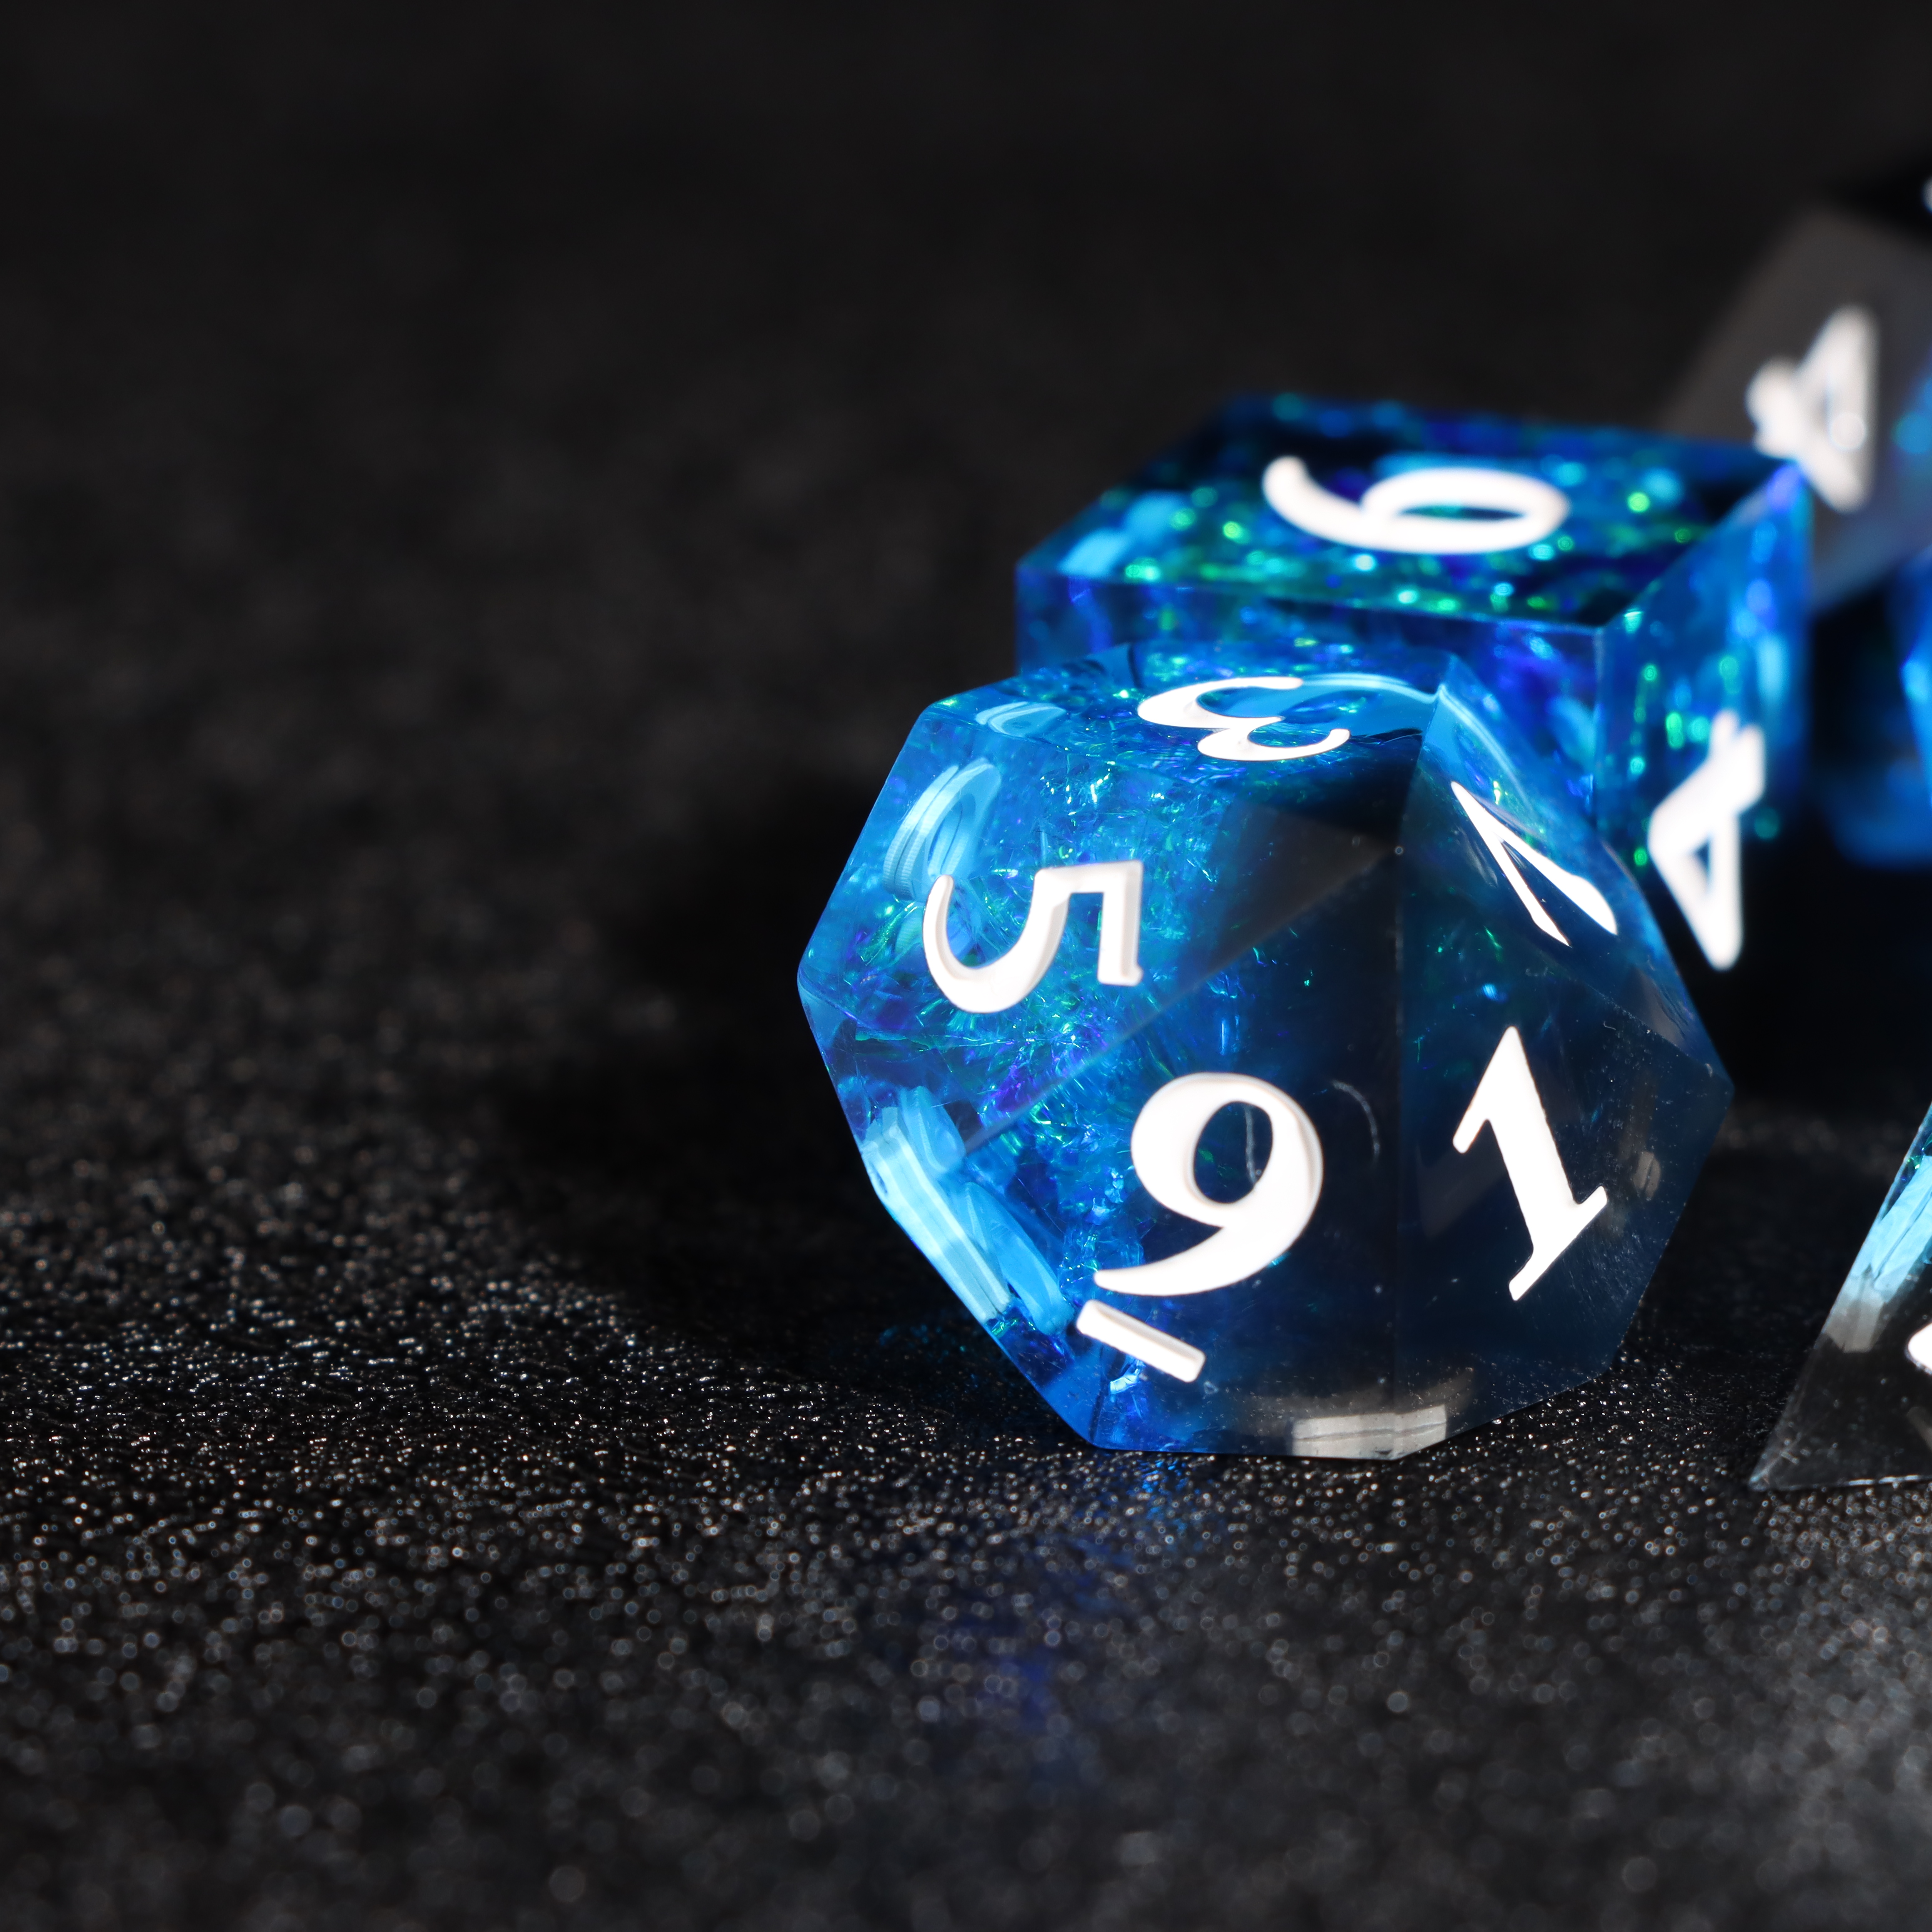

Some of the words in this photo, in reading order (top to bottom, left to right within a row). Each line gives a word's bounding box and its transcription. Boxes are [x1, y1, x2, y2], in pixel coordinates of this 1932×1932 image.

[1138, 676, 1350, 762] 3
[922, 859, 1143, 1013] 5
[1451, 781, 1618, 947] 7
[1648, 710, 1765, 969] 4
[1093, 1073, 1323, 1296] 9
[1452, 1026, 1608, 1301] 1
